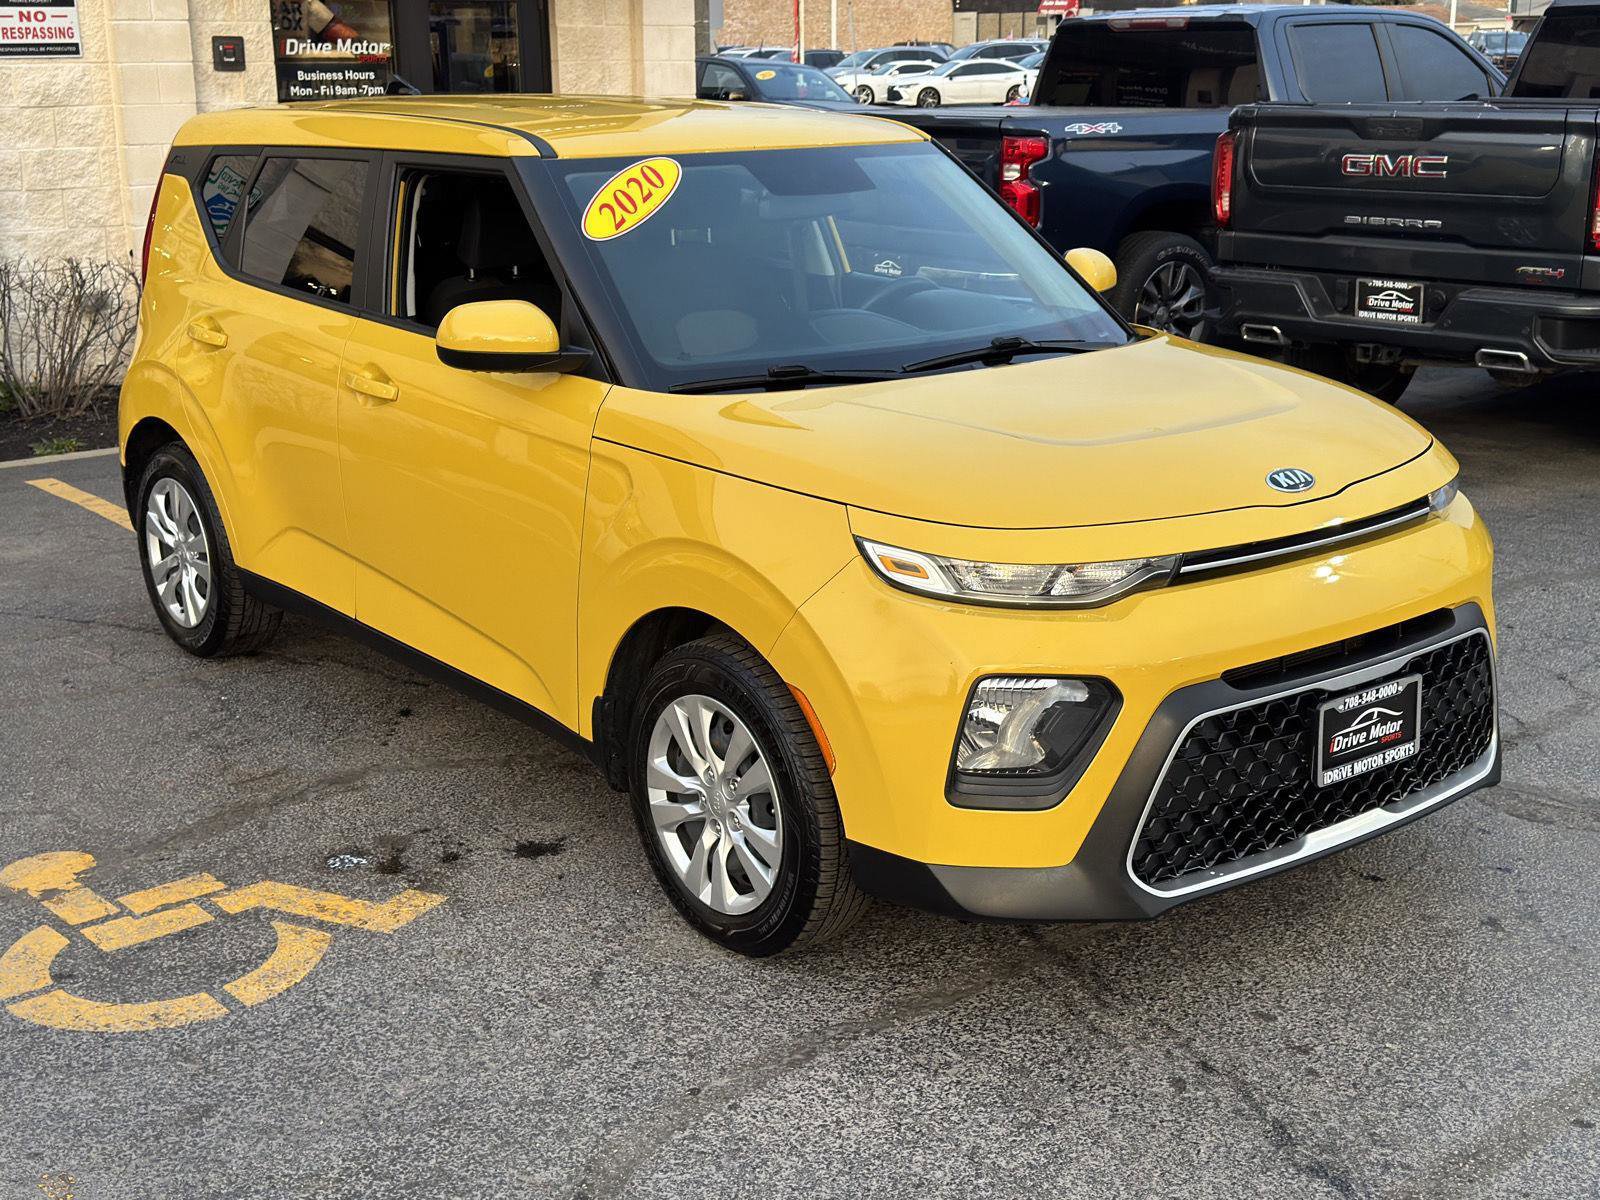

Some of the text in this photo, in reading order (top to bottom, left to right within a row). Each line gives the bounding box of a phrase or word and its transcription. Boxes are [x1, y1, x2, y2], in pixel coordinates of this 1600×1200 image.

[18, 11, 47, 22] NO
[0, 26, 75, 39] RESPASSING
[336, 38, 391, 55] Motor
[297, 70, 375, 81] Business Hours
[290, 86, 312, 96] Mon
[335, 85, 357, 95] 9am
[1341, 154, 1448, 178] GMC
[599, 165, 665, 231] 2020
[1344, 215, 1442, 228] SIERRA
[1391, 299, 1414, 309] Motor
[1377, 312, 1397, 321] MOTOR
[1397, 313, 1418, 323] SPORTS
[1271, 469, 1313, 488] KIA
[1343, 682, 1398, 710] 708-348-0000
[1369, 719, 1403, 740] Motor
[1380, 731, 1402, 743] SPORTS
[1353, 753, 1383, 774] MOTOR
[1384, 742, 1415, 763] SPORTS
